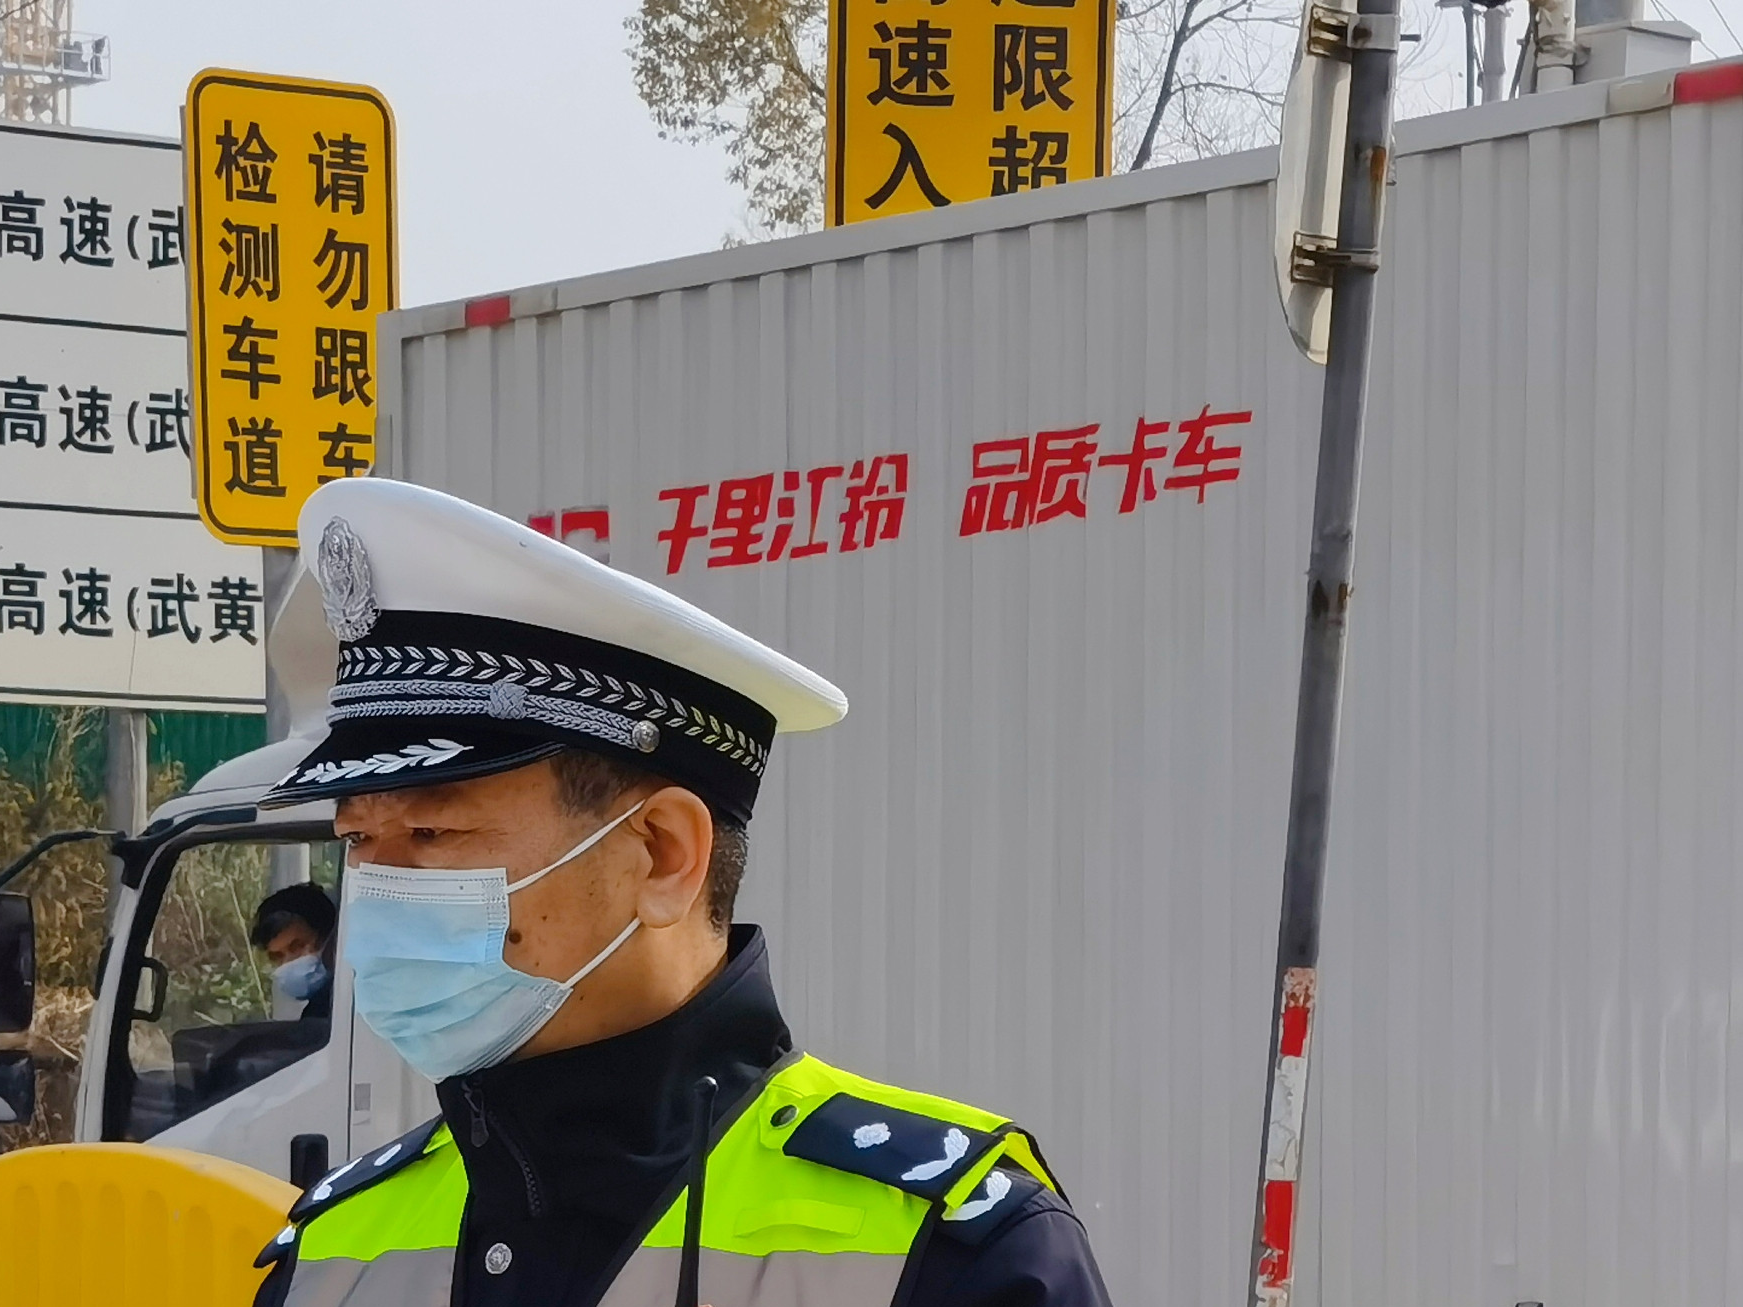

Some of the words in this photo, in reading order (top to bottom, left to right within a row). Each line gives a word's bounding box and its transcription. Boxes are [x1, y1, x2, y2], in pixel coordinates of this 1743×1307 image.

[215, 119, 287, 497] 检测车道
[308, 131, 374, 485] 请勿跟车
[959, 403, 1253, 537] 品质卡车
